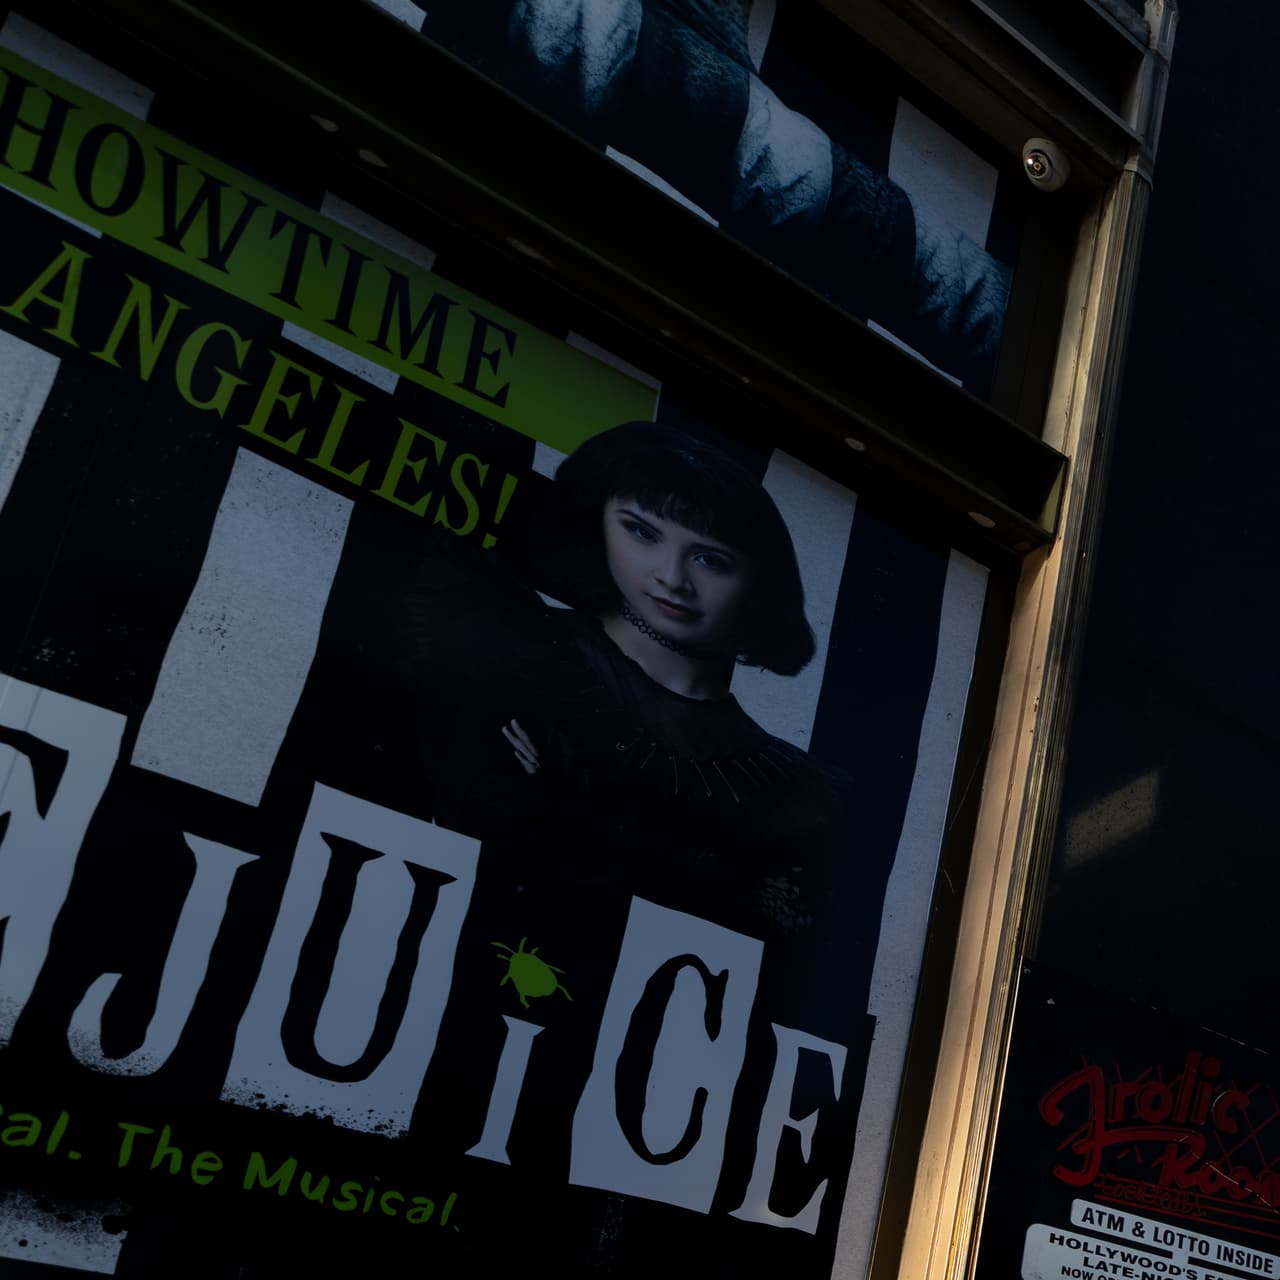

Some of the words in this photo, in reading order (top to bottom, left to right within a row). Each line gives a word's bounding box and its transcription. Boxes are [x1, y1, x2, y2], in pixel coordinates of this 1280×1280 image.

[0, 239, 518, 550] ANGELES!
[0, 1103, 83, 1162] al.
[117, 1122, 225, 1186] The
[243, 1154, 462, 1233] Musical.
[1040, 1051, 1252, 1187] Frolic
[1049, 1232, 1200, 1280] HOLLYWOOD'S
[1081, 1206, 1125, 1234] ATM
[1132, 1221, 1147, 1239] &
[1153, 1226, 1212, 1257] LOTTO
[1216, 1243, 1275, 1274] INSIDE
